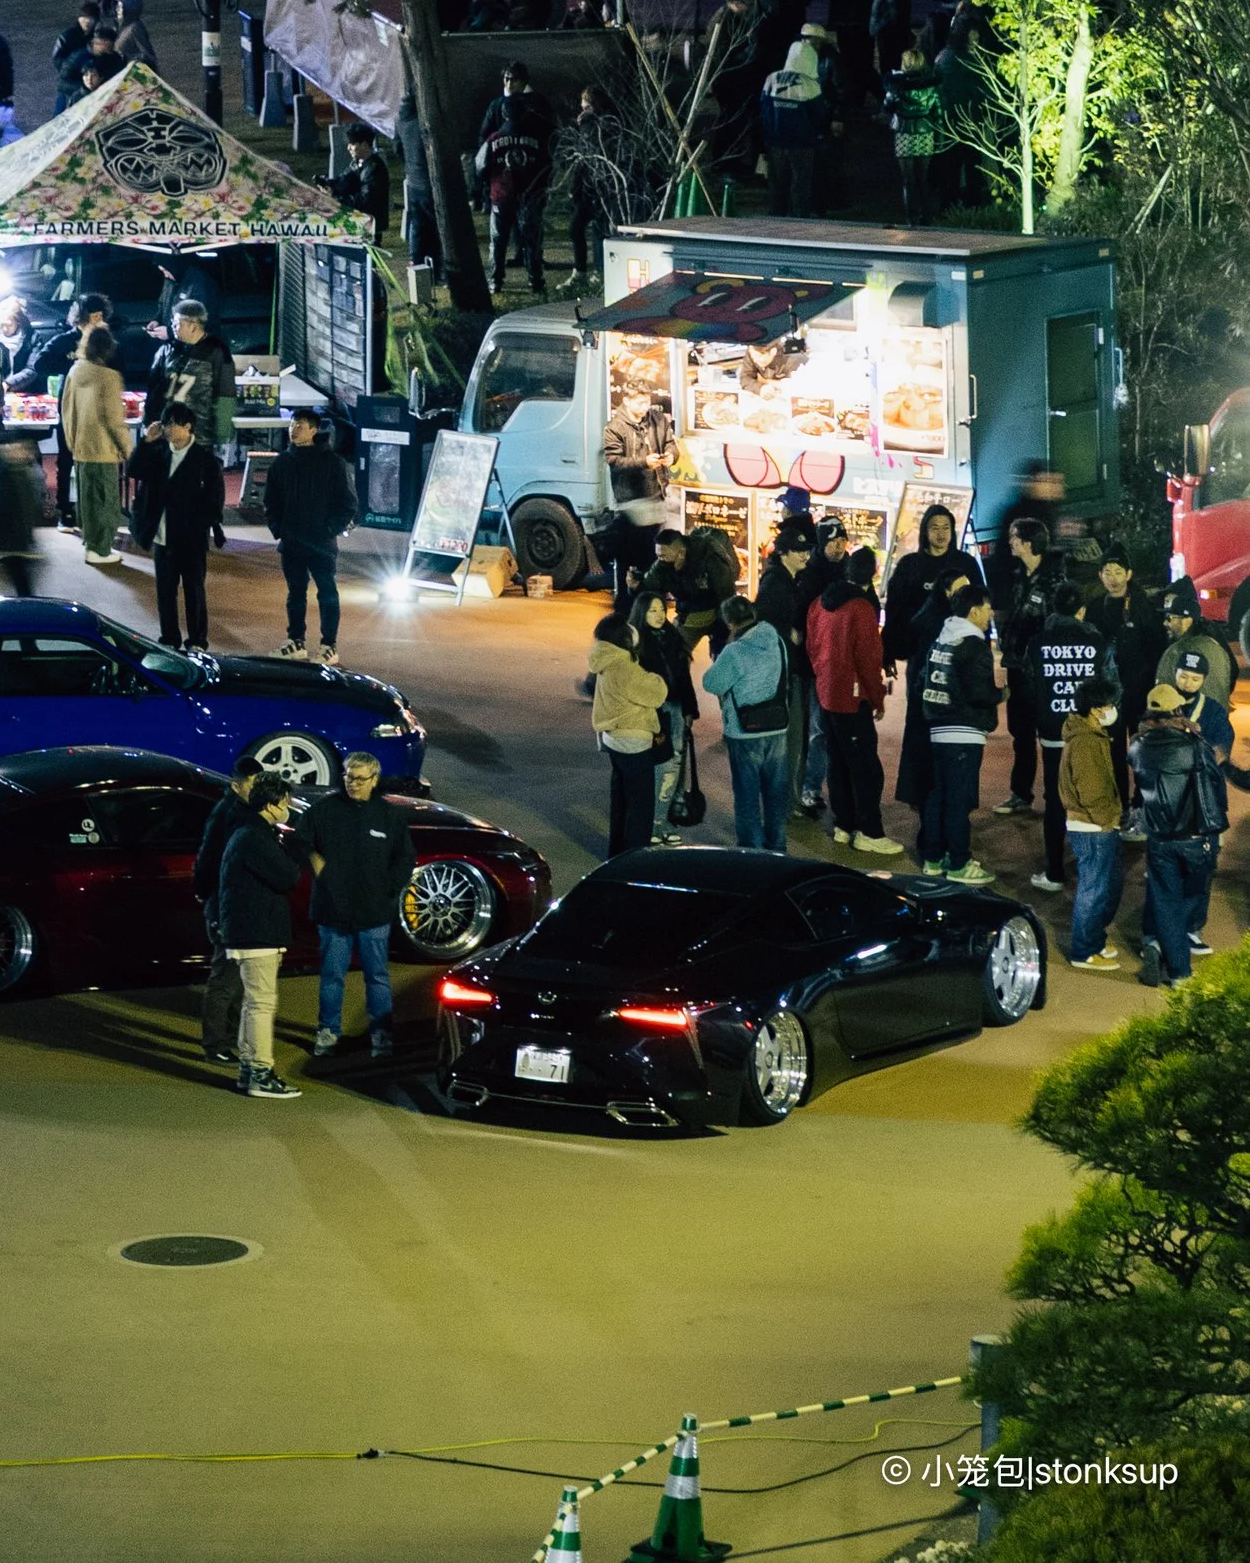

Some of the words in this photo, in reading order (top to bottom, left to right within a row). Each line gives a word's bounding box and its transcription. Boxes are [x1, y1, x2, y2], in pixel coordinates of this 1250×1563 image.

[34, 221, 139, 235] FARMERS
[149, 222, 241, 236] MARKET
[250, 223, 329, 237] HAWAII
[1041, 645, 1097, 659] TOKYO
[1043, 663, 1095, 677] DRIVE
[1053, 681, 1083, 695] CA
[1051, 698, 1078, 713] CLU
[549, 1064, 566, 1080] 71
